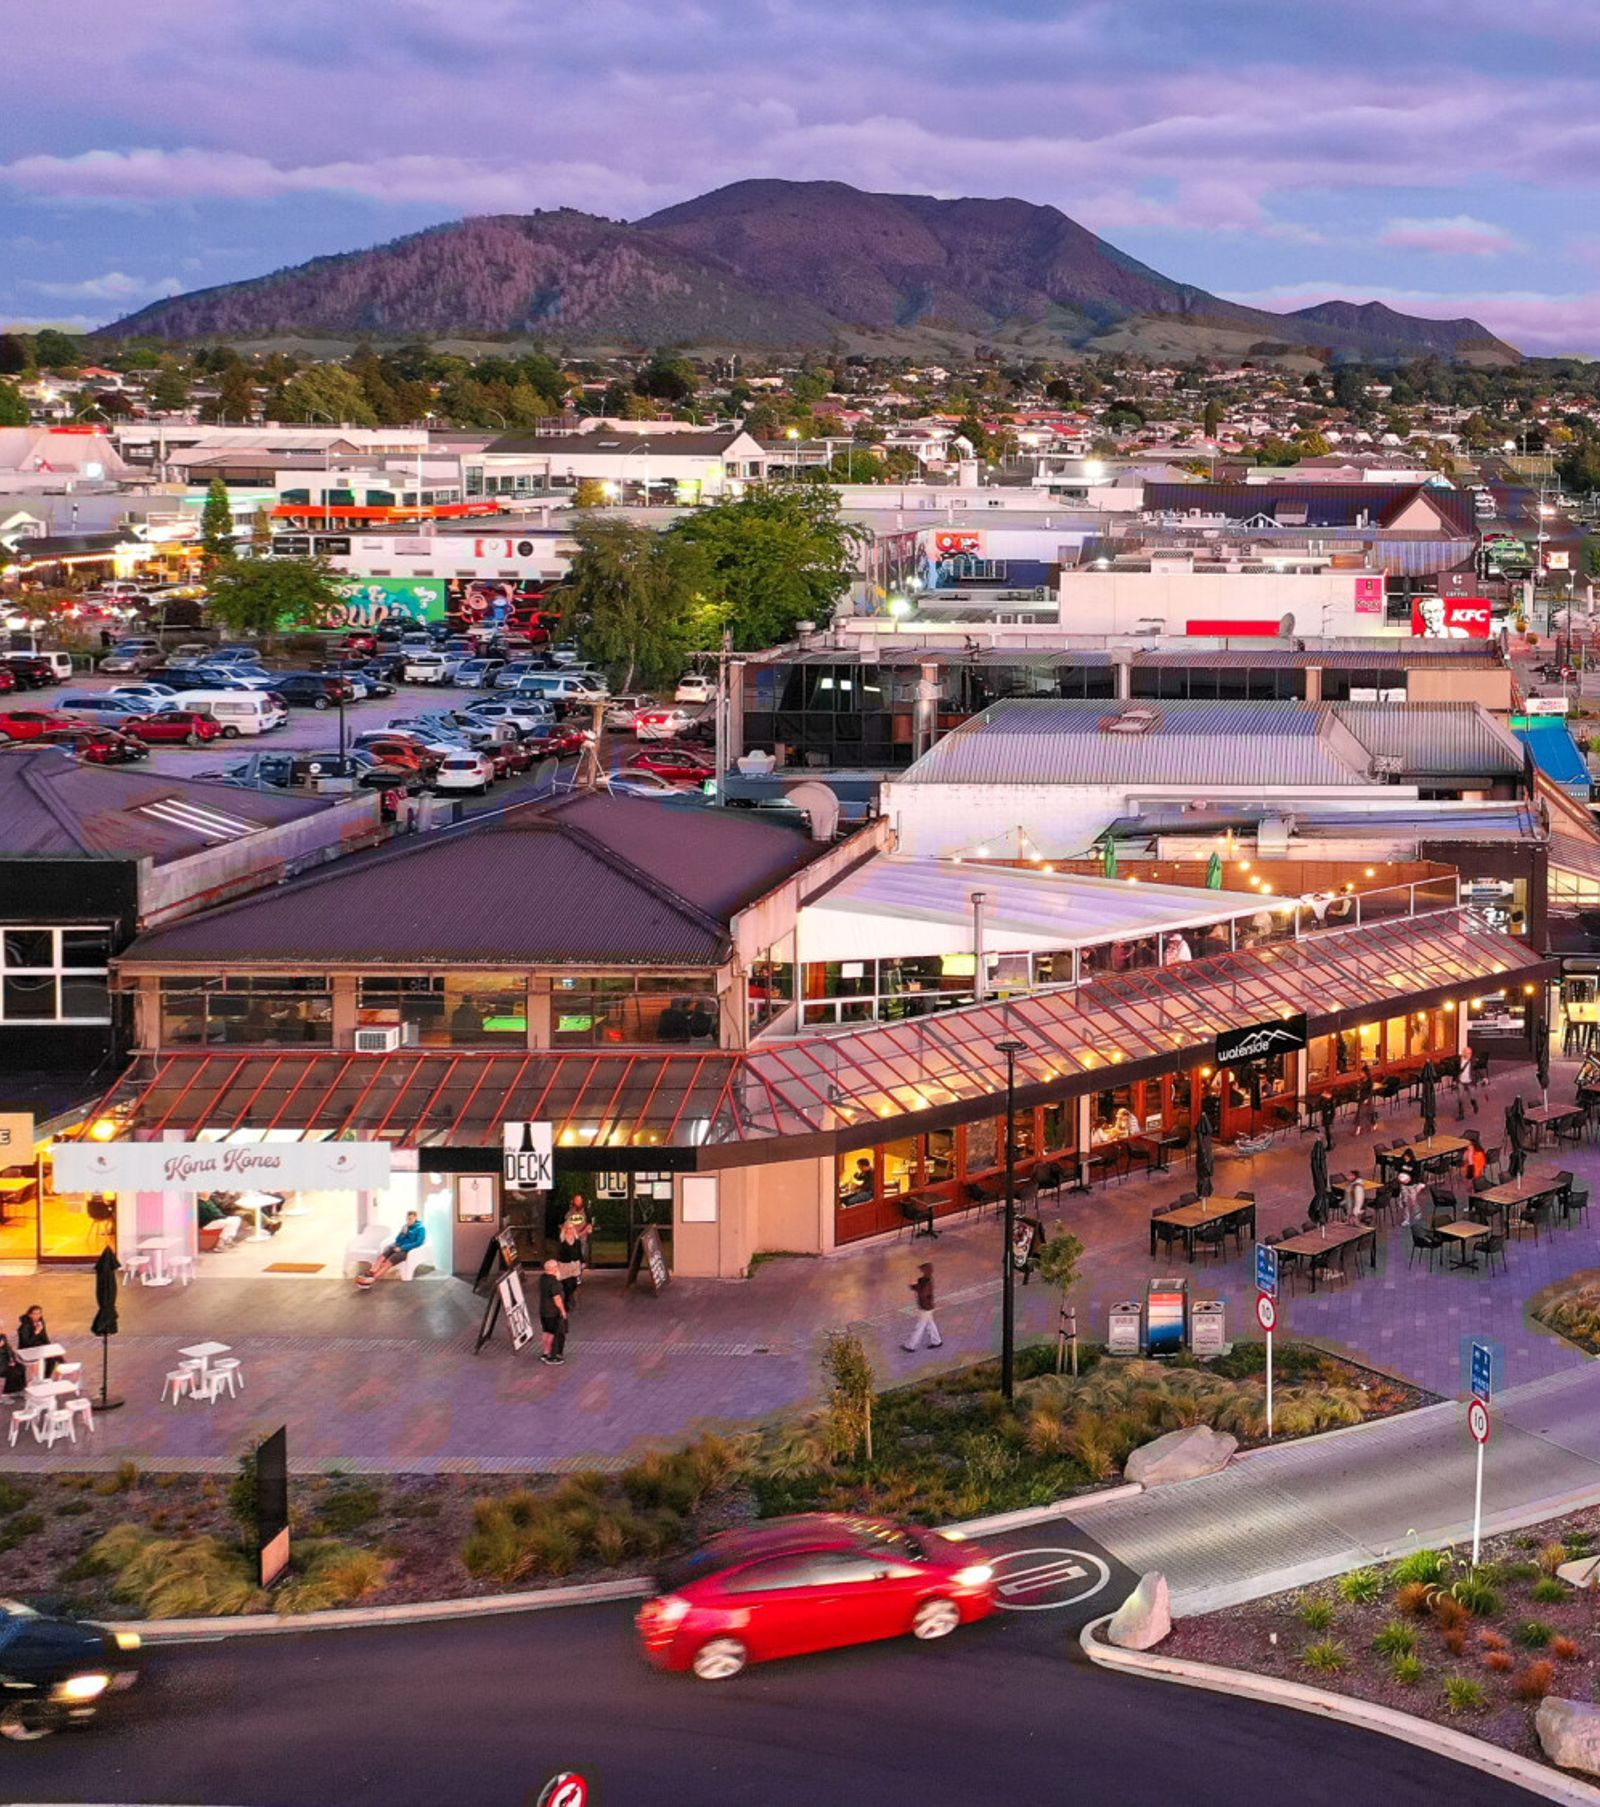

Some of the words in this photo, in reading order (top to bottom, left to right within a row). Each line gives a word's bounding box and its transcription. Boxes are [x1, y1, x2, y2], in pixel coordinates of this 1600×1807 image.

[1451, 609, 1488, 622] KFC
[1217, 1037, 1270, 1062] waterside
[164, 1153, 217, 1182] Kona
[223, 1148, 282, 1174] Kones
[504, 1154, 553, 1182] DECK
[1261, 1303, 1272, 1321] 10
[1474, 1412, 1484, 1431] 10
